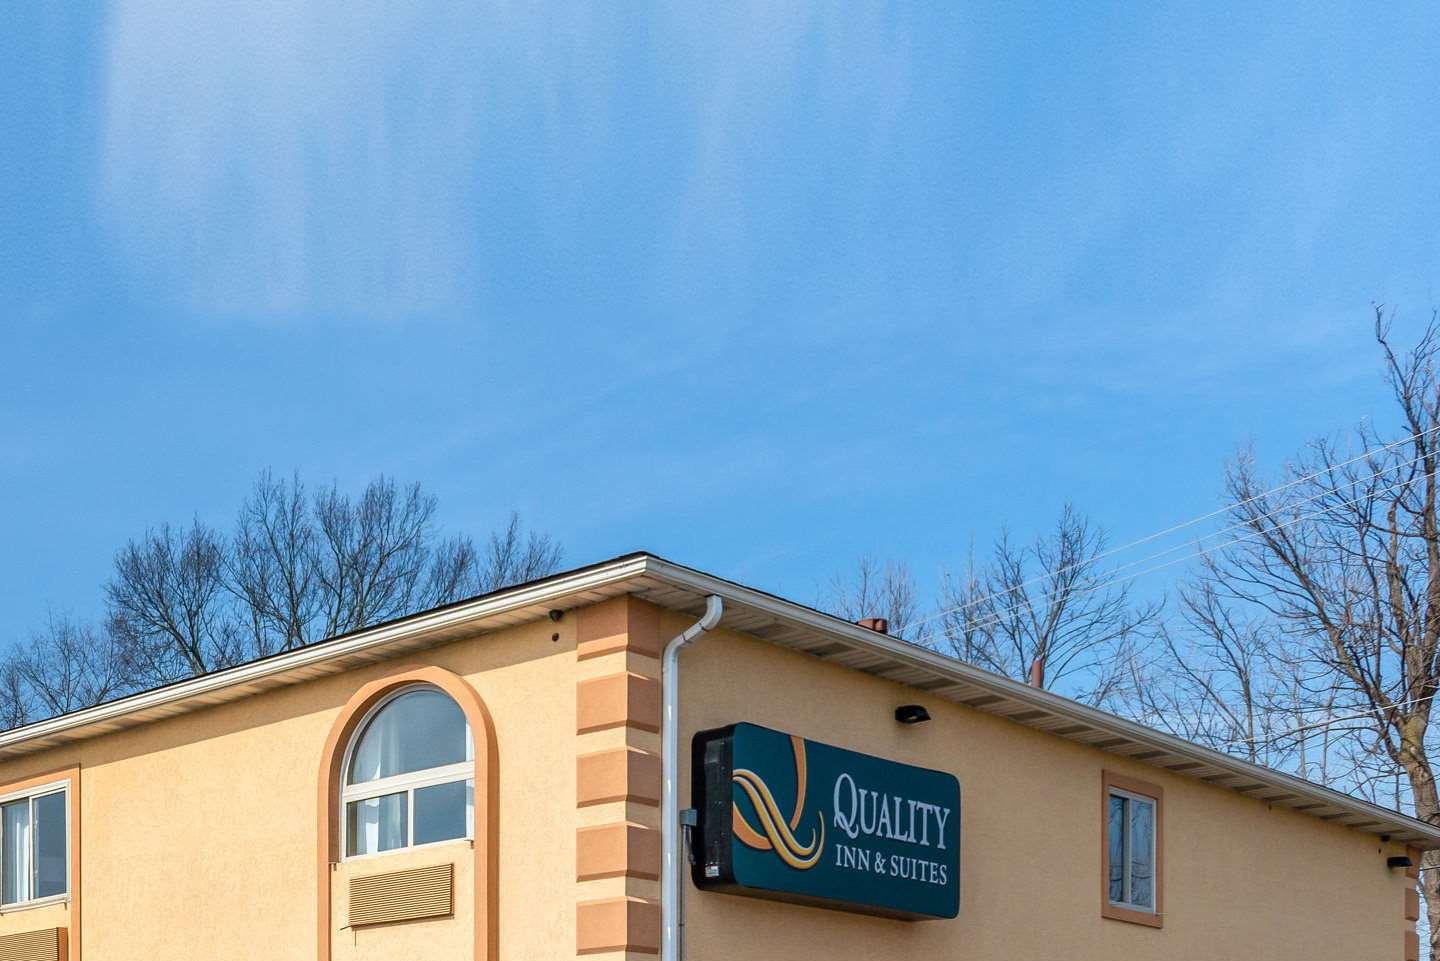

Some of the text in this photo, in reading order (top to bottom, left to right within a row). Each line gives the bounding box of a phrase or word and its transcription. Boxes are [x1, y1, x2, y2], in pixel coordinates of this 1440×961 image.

[833, 773, 950, 850] QUALITY
[835, 843, 948, 885] INN & SUITES
